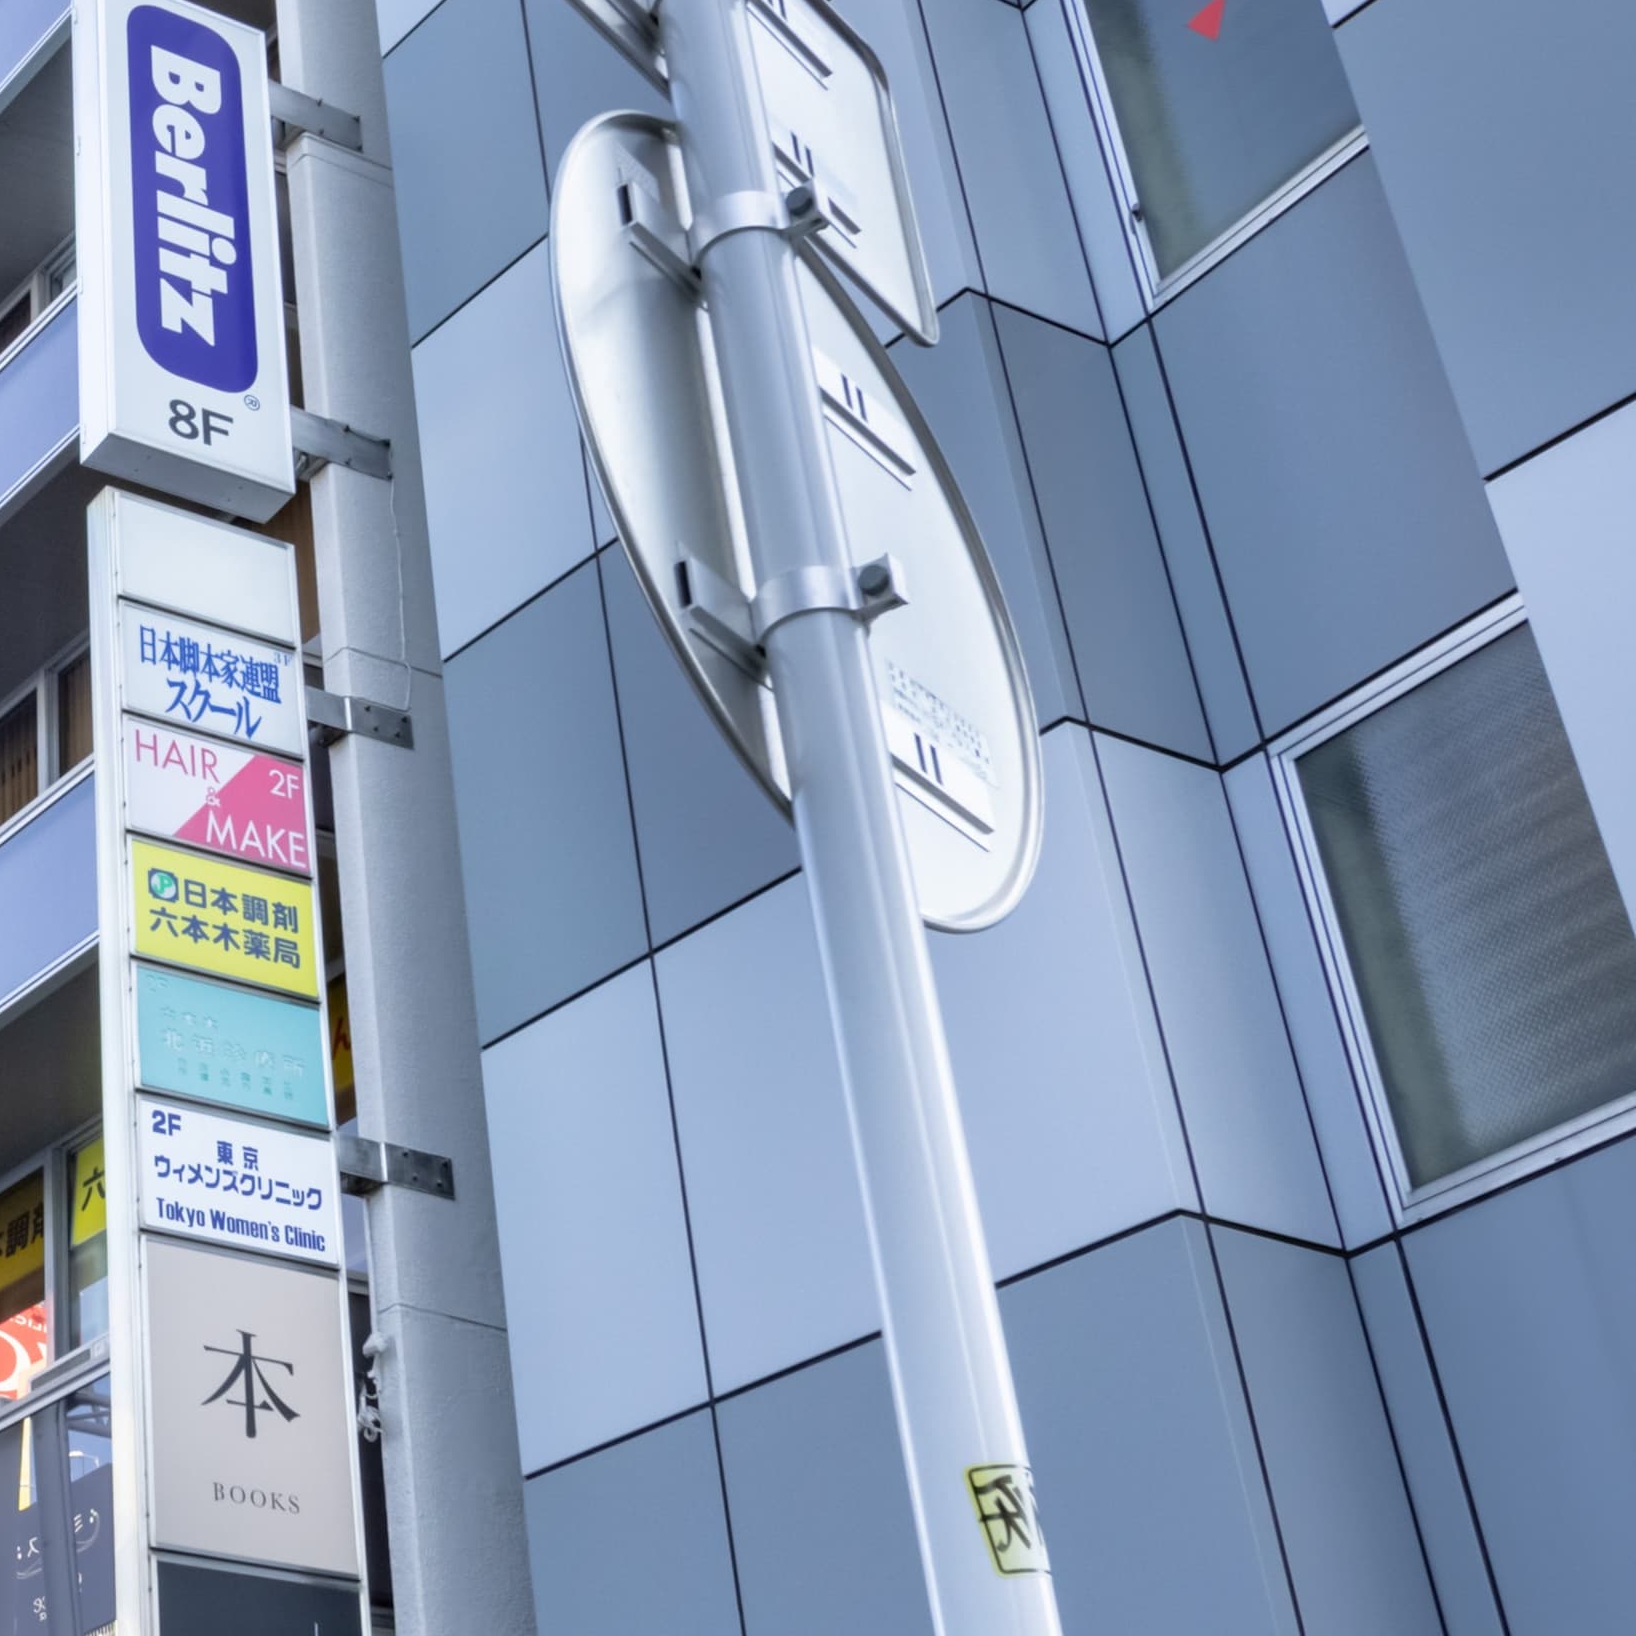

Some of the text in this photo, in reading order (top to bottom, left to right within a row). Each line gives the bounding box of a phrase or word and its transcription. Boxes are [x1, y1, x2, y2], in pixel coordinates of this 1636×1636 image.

[150, 44, 236, 346] Berlitz
[167, 399, 233, 446] 8F
[140, 624, 281, 704] 日本脚本家連盟
[165, 679, 262, 739] スクール
[135, 729, 219, 783] HAIR
[269, 769, 299, 799] 2F
[206, 810, 307, 869] MAKE
[183, 878, 299, 933] 日本調剤
[150, 907, 300, 968] 六本木薬局
[152, 1110, 181, 1136] 2F
[154, 1153, 323, 1211] ウィメンズクリニック
[217, 1139, 259, 1170] 東京
[157, 1196, 325, 1253] Tokyo Women's Clinic
[201, 1328, 301, 1439] 本
[212, 1482, 302, 1516] BOOKS
